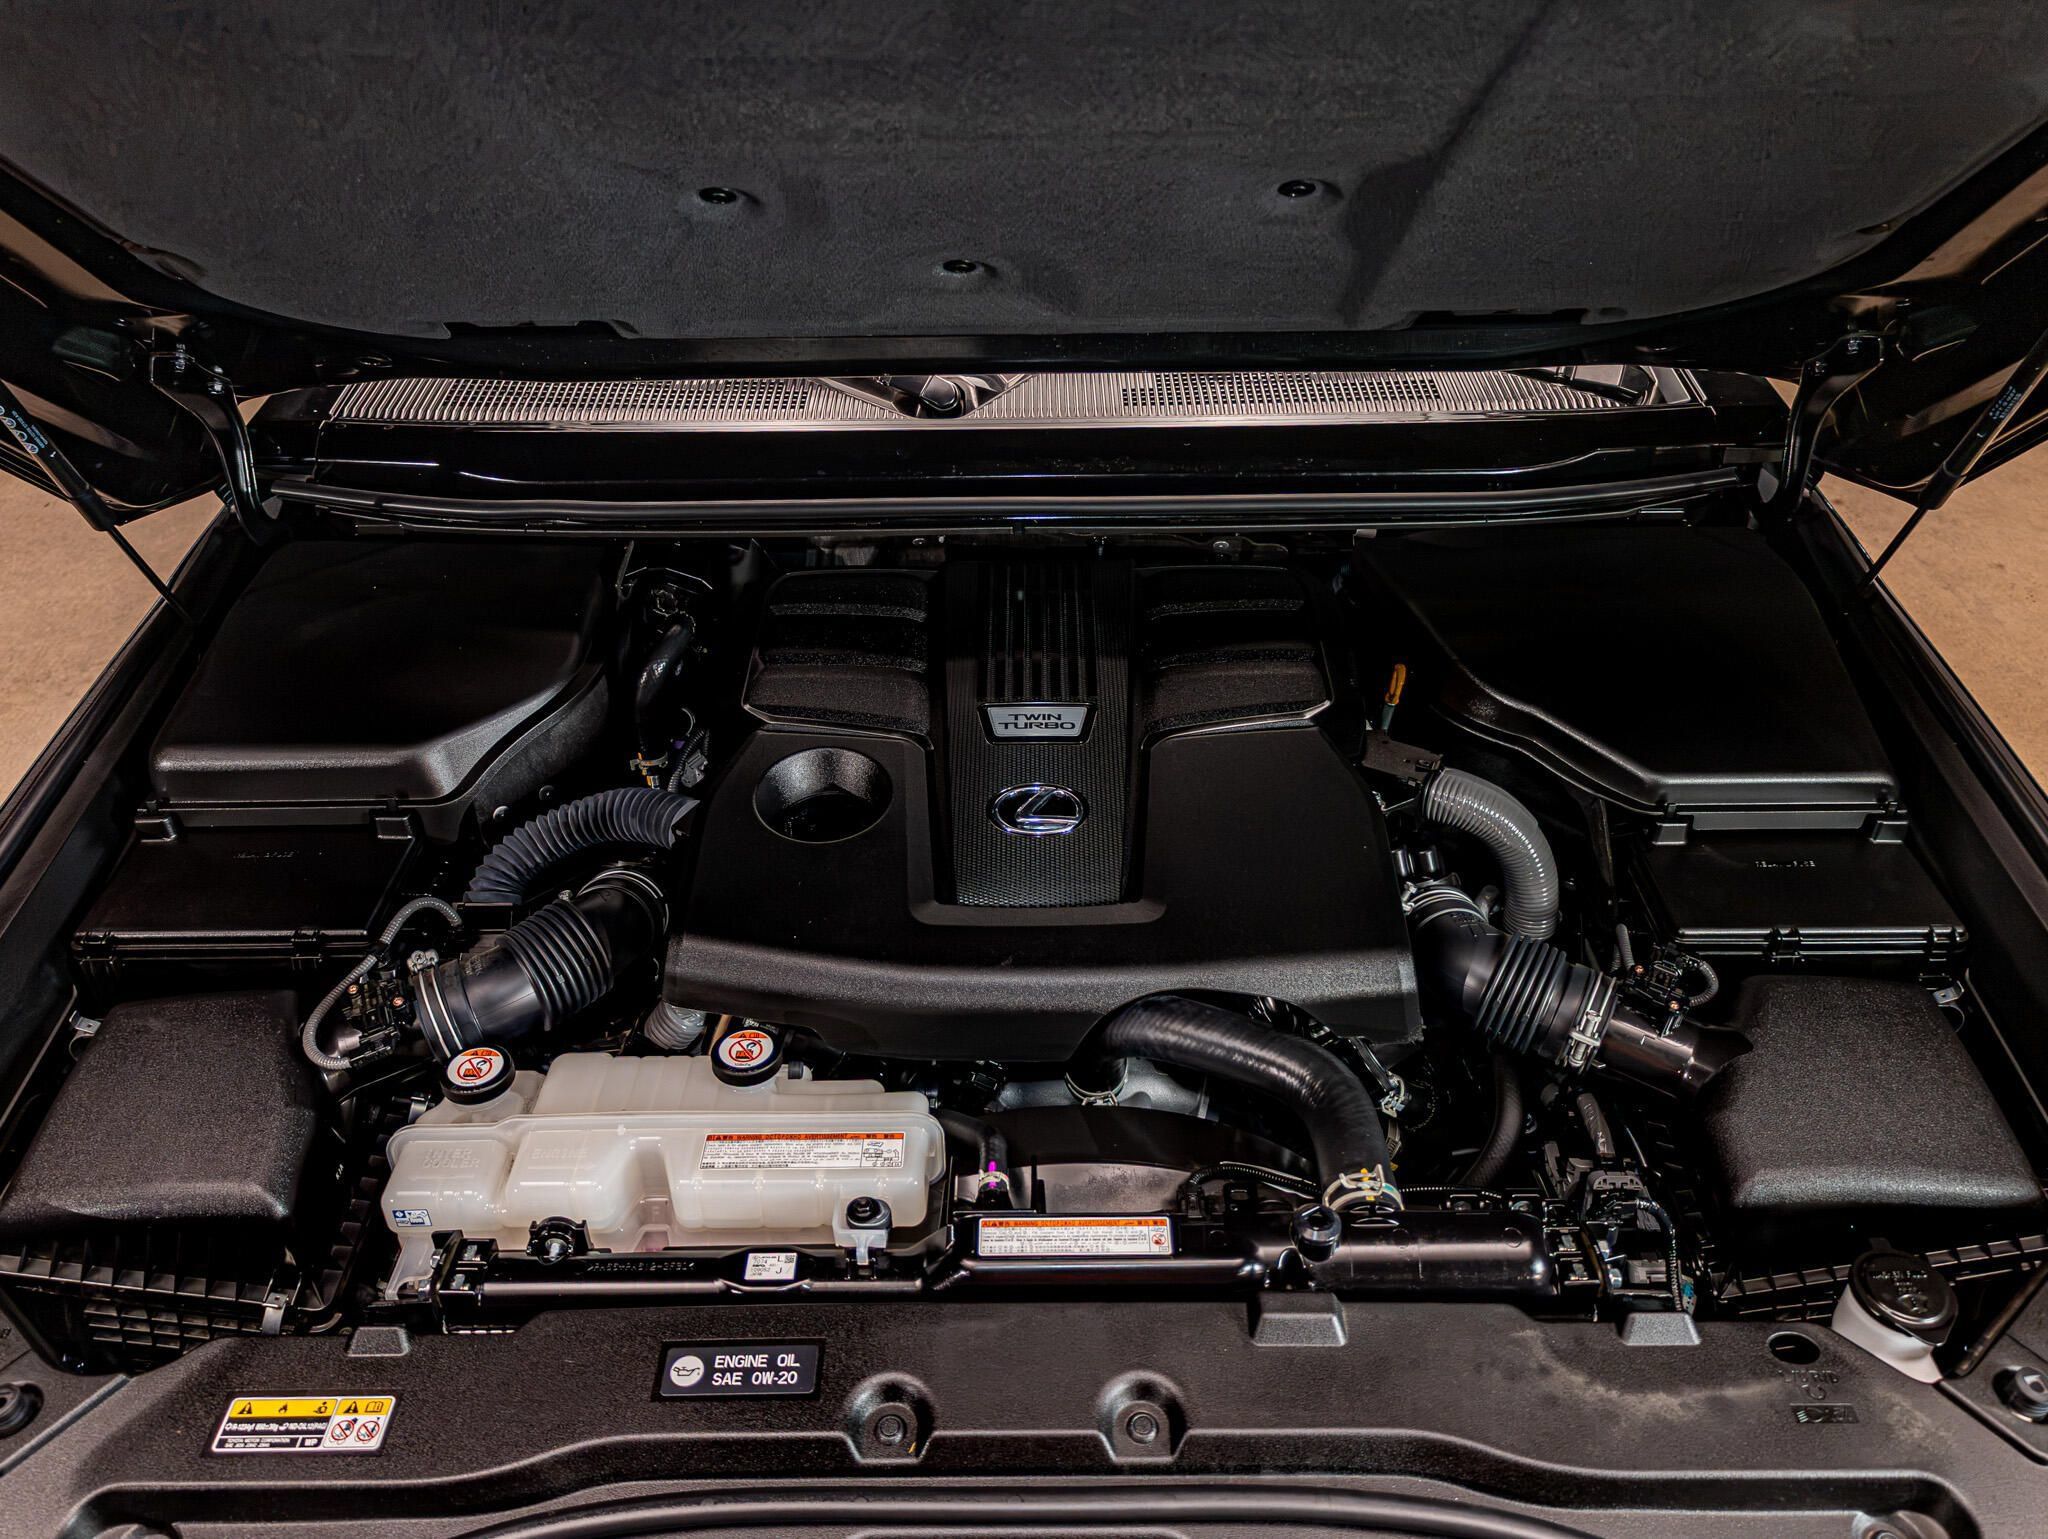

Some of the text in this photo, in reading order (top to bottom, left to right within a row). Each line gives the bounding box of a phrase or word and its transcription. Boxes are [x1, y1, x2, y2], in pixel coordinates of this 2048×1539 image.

[1008, 713, 1062, 721] TWIN
[998, 722, 1076, 730] TURBO
[423, 1148, 473, 1159] INTER
[422, 1158, 480, 1169] COOLER
[714, 1353, 801, 1369] ENGINE OIL
[711, 1371, 799, 1386] SAE 0W-20
